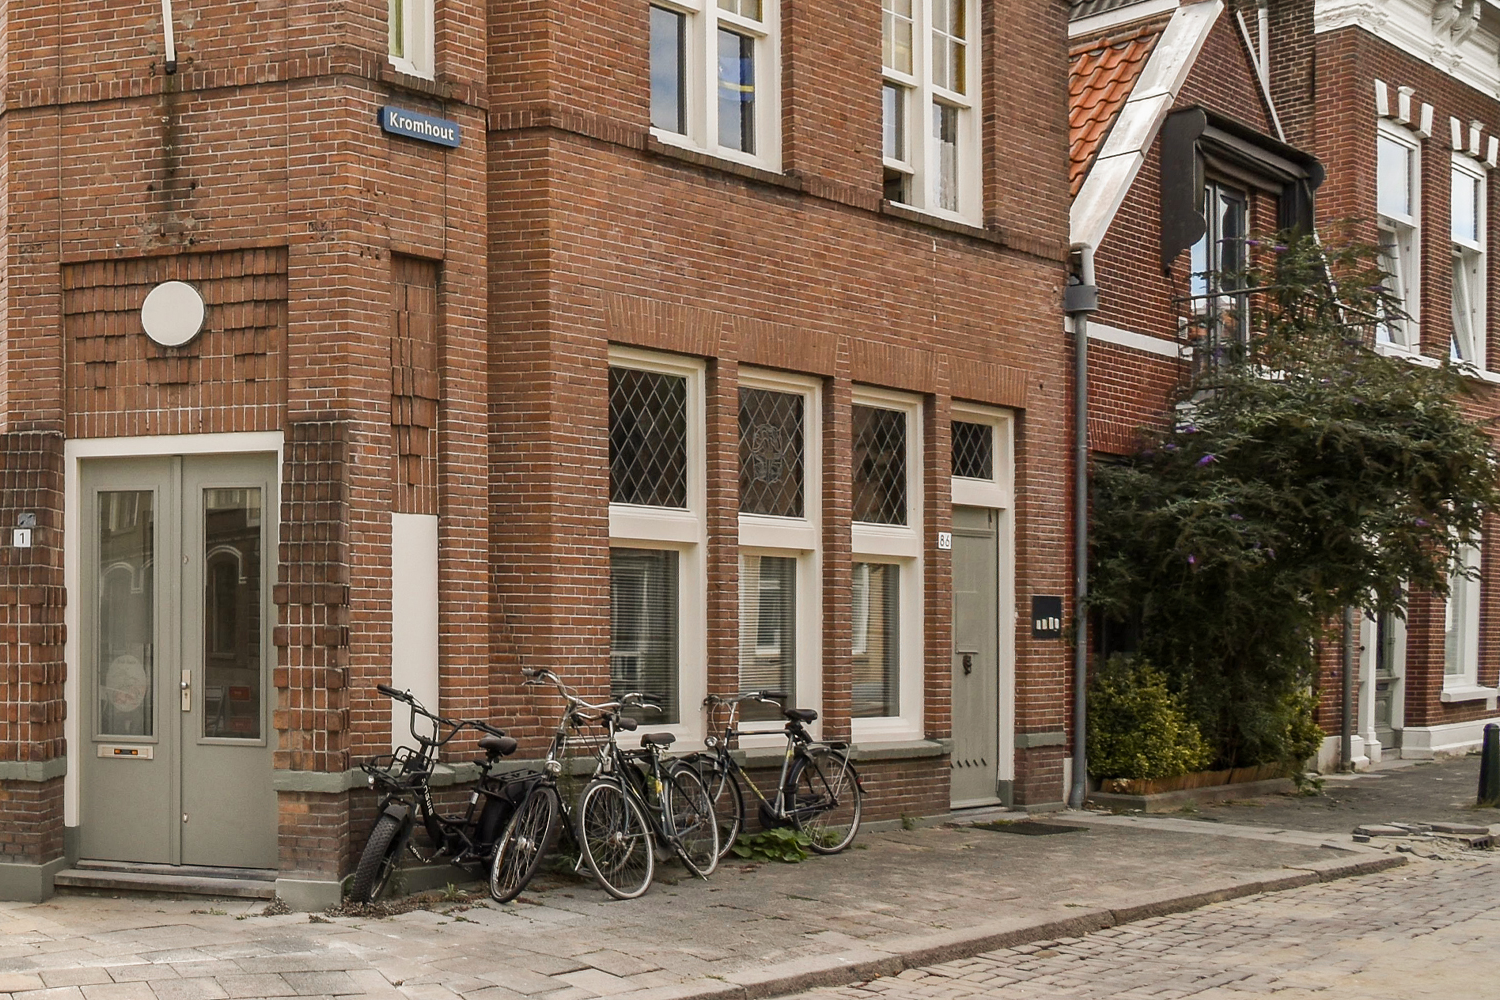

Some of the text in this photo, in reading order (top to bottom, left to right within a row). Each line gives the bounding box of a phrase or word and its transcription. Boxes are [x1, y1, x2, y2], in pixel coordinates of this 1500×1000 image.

[389, 111, 454, 141] Kromhout
[19, 532, 25, 545] 1
[939, 534, 950, 547] 86
